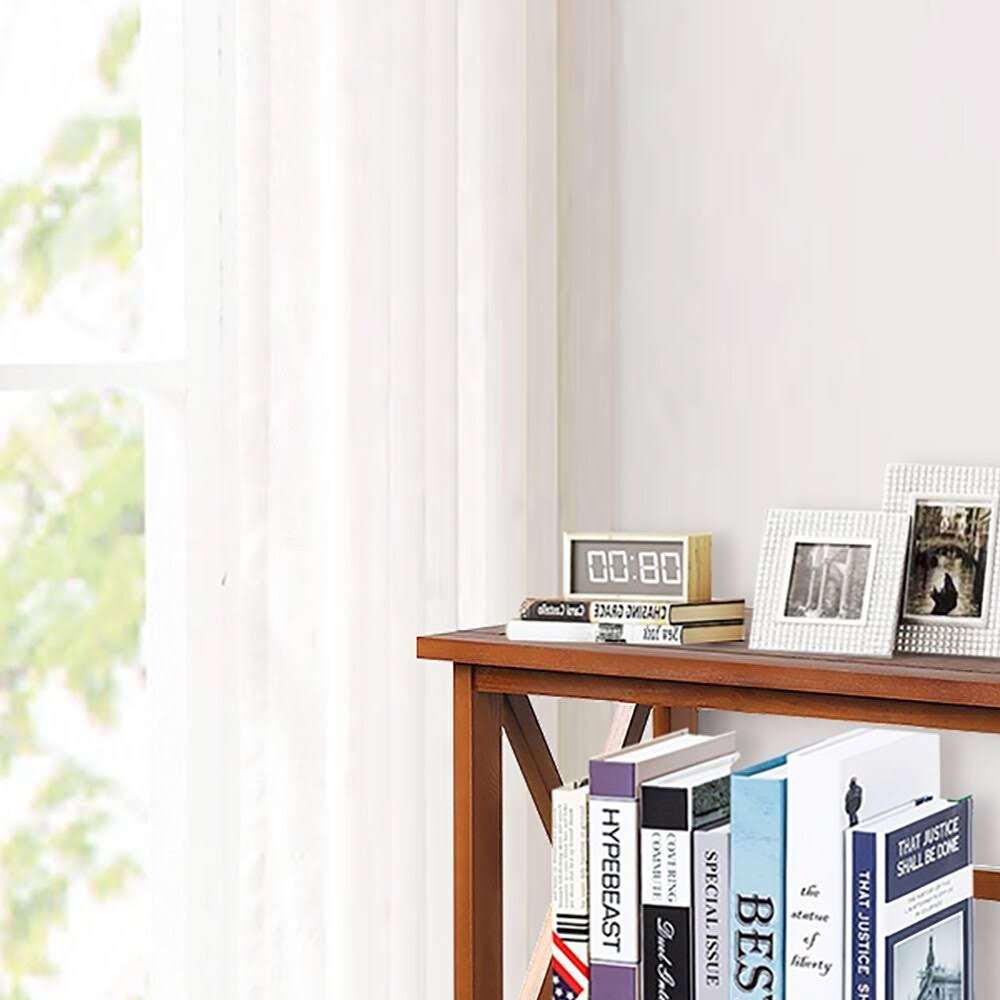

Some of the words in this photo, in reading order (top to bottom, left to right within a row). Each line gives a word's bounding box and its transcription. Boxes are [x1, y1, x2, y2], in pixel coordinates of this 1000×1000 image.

[896, 852, 924, 877] SHALL
[924, 845, 937, 865] BE
[936, 835, 960, 859] DONE
[898, 832, 922, 857] THAT
[922, 816, 960, 847] JUSTICE
[601, 808, 621, 953] HYPEBEAST
[666, 832, 677, 903] COVERING
[704, 849, 719, 929] SPECIAL
[800, 884, 821, 898] the
[858, 871, 871, 908] THAT
[705, 934, 720, 987] ISSUE
[803, 931, 821, 951] of
[857, 912, 870, 975] JUSTICE
[790, 953, 833, 977] liberty
